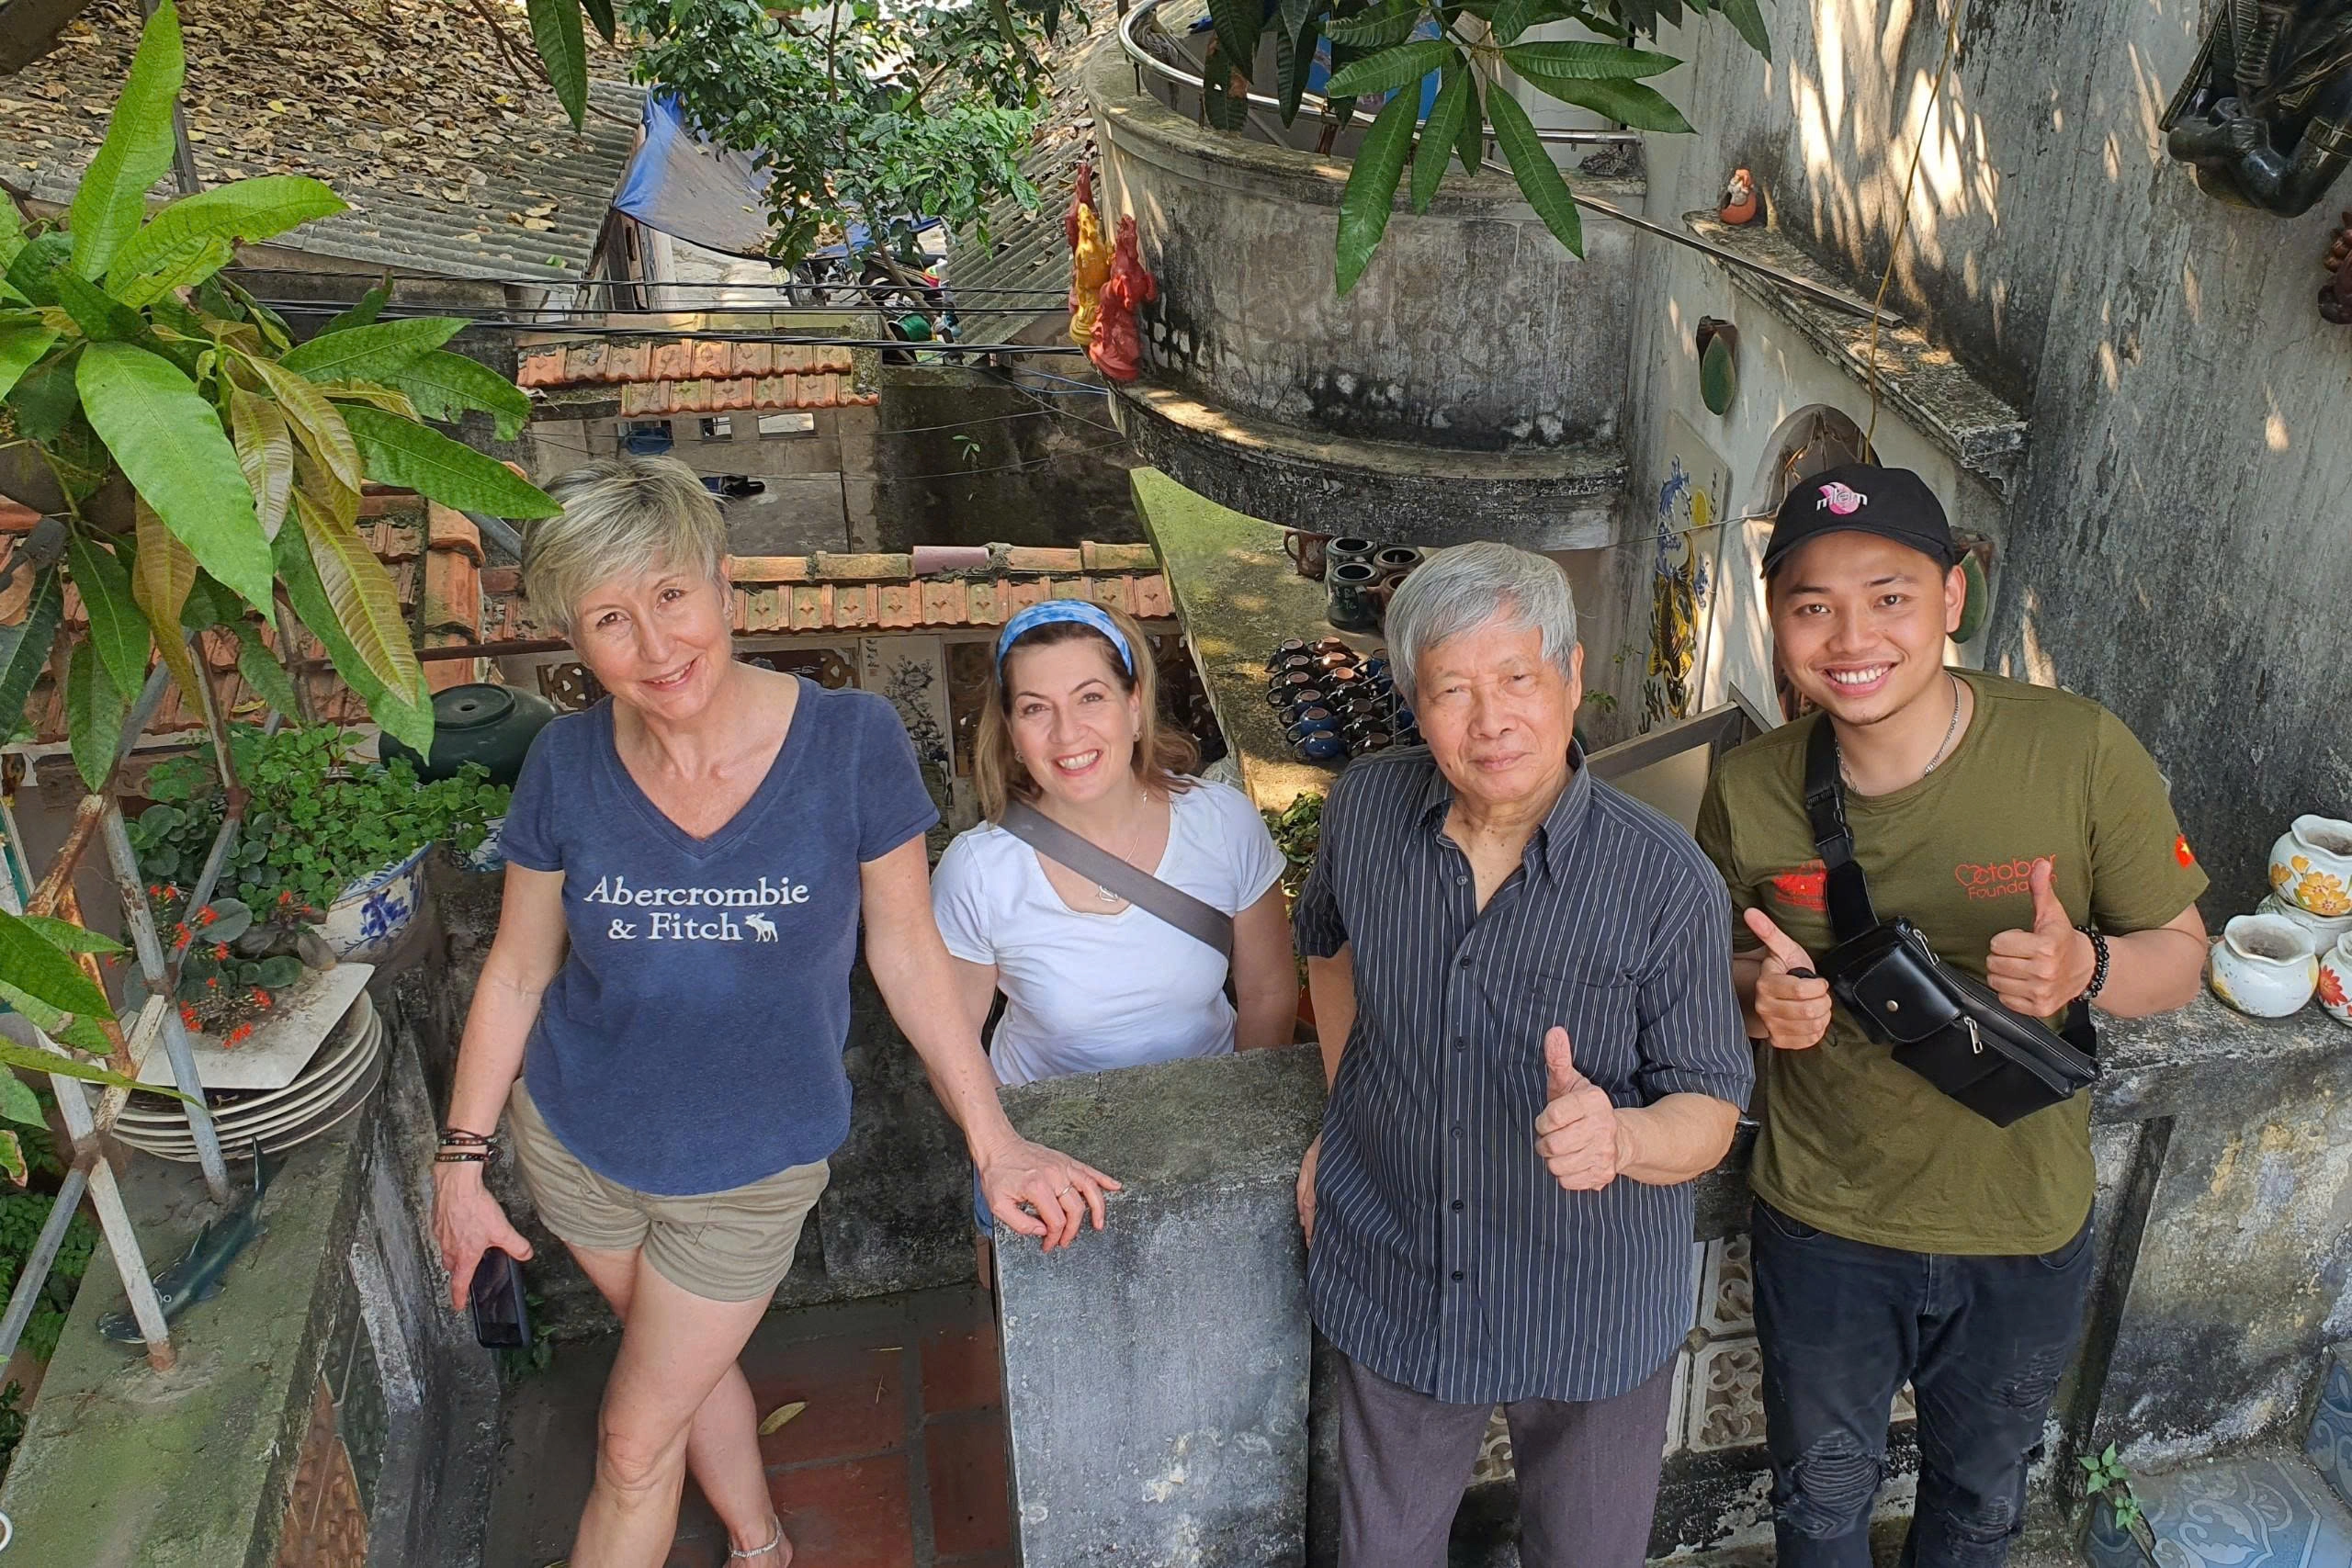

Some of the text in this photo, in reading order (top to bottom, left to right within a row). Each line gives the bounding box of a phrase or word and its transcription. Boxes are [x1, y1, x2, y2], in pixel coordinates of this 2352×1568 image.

[583, 874, 810, 907] Abercrombie
[607, 912, 743, 941] & Fitch
